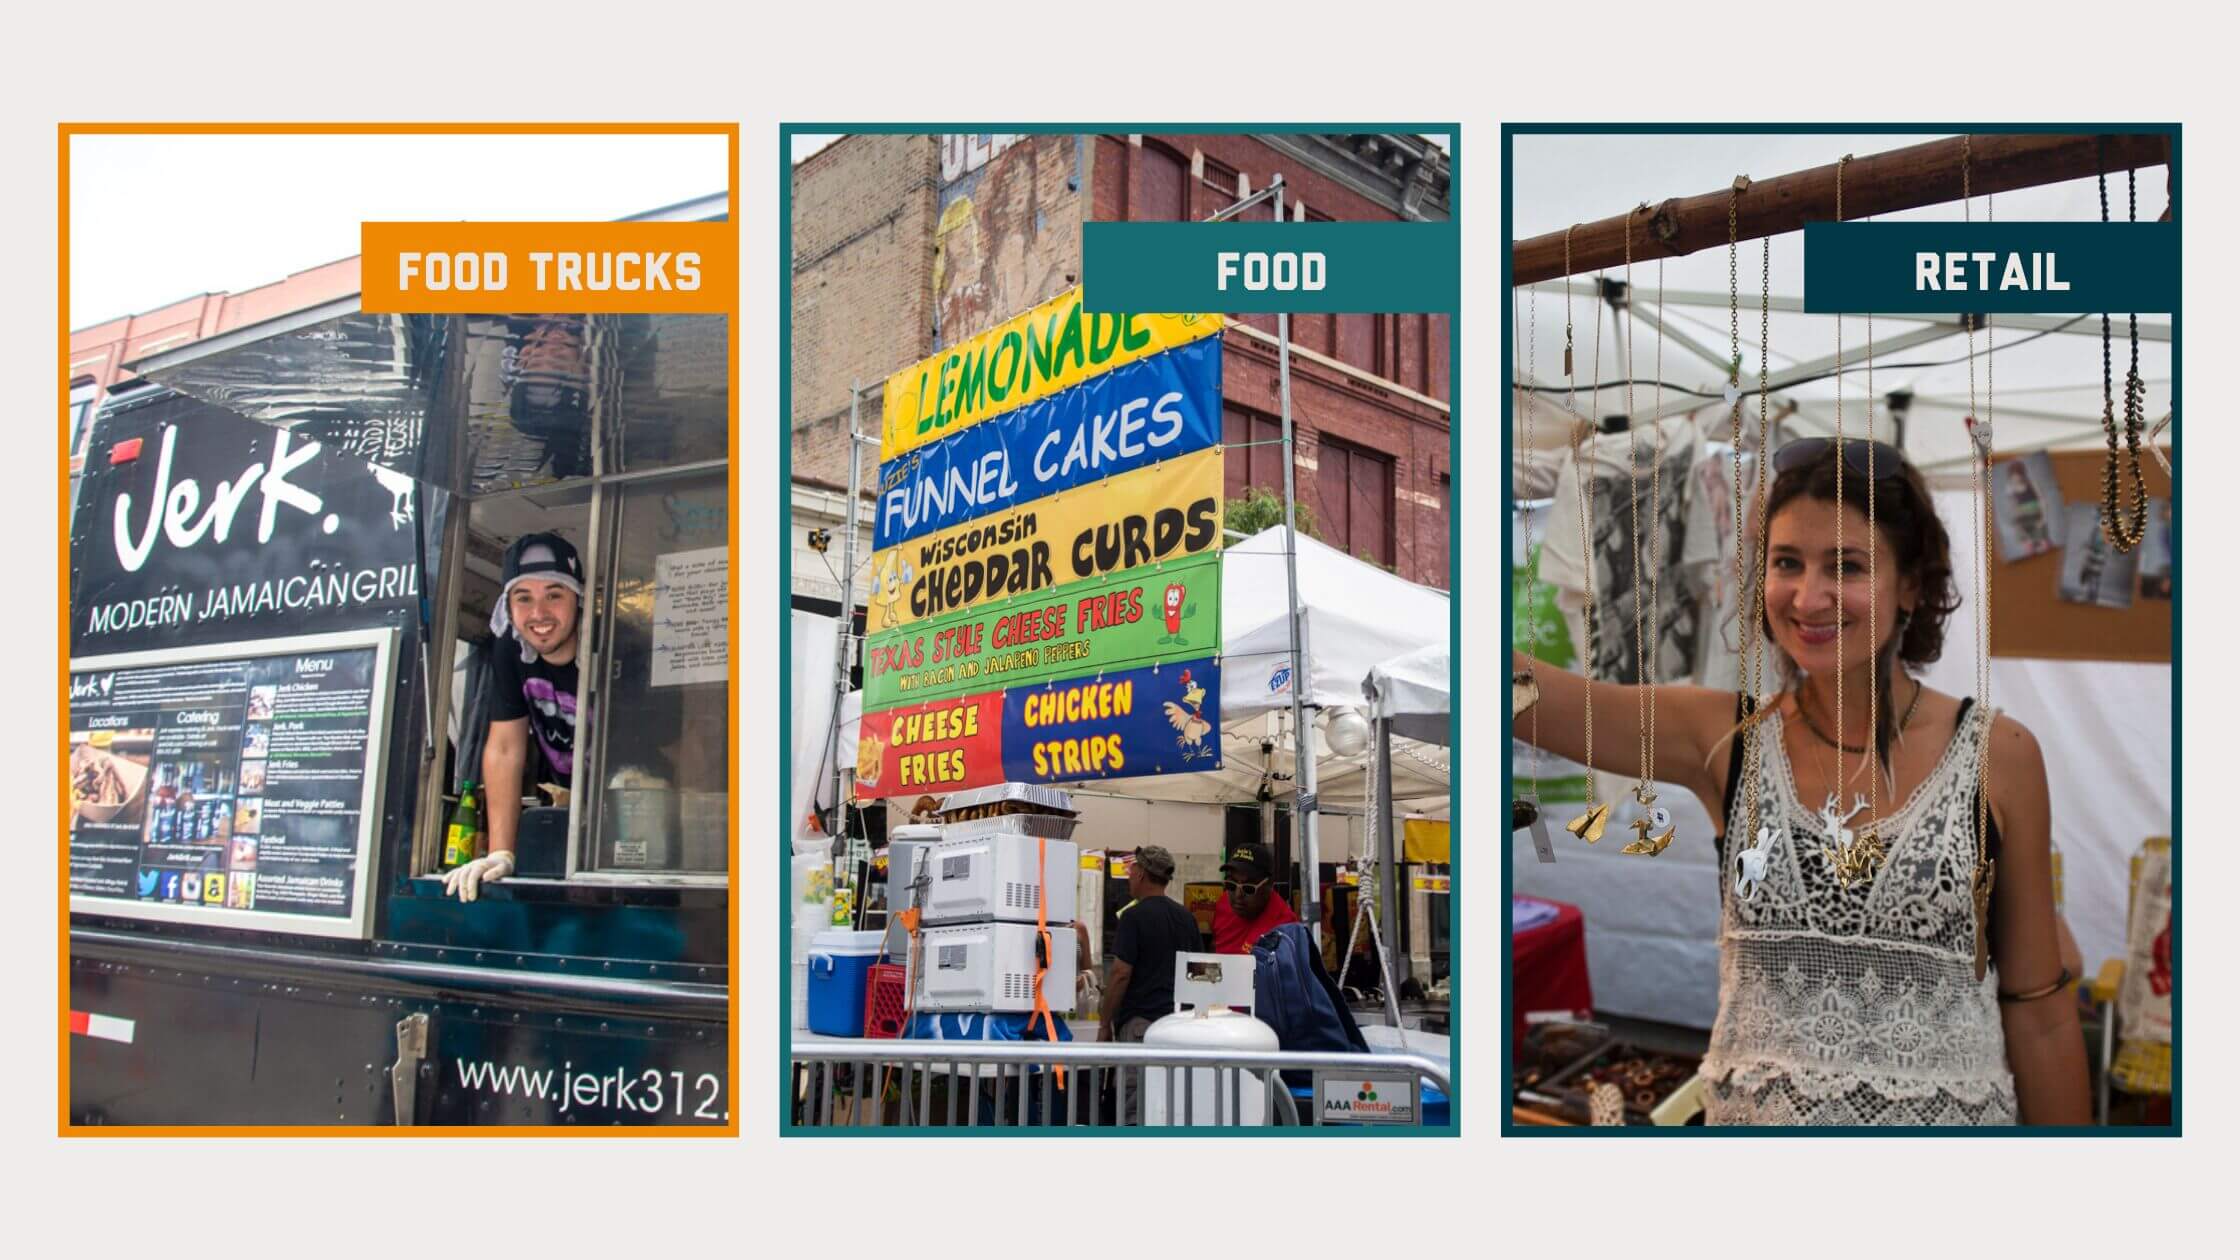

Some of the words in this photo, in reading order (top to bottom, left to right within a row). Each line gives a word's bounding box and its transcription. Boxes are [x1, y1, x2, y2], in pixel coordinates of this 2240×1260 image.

[916, 302, 1152, 436] LEMONADE
[883, 448, 1019, 539] FUNNEL
[1032, 391, 1184, 484] CAKES
[1071, 496, 1218, 579] CURDS
[88, 593, 194, 633] MODERN
[198, 571, 350, 621] JAMAICAN
[869, 636, 925, 679] TEXAS
[931, 622, 985, 666] STYLE
[991, 603, 1068, 651] CHEESE
[1076, 586, 1145, 635] FRIES
[295, 657, 334, 673] Menu
[899, 673, 921, 692] WITH
[923, 664, 956, 686] BACON
[958, 660, 980, 681] AND
[1043, 638, 1091, 666] PEPPERS
[88, 716, 129, 728] Locations
[176, 711, 220, 726] Catering
[889, 703, 980, 748] CHEESE
[1023, 679, 1133, 729] CHICKEN
[899, 747, 967, 787] FRIES
[1032, 732, 1126, 778] STRIPS
[1325, 1100, 1351, 1110] AAA
